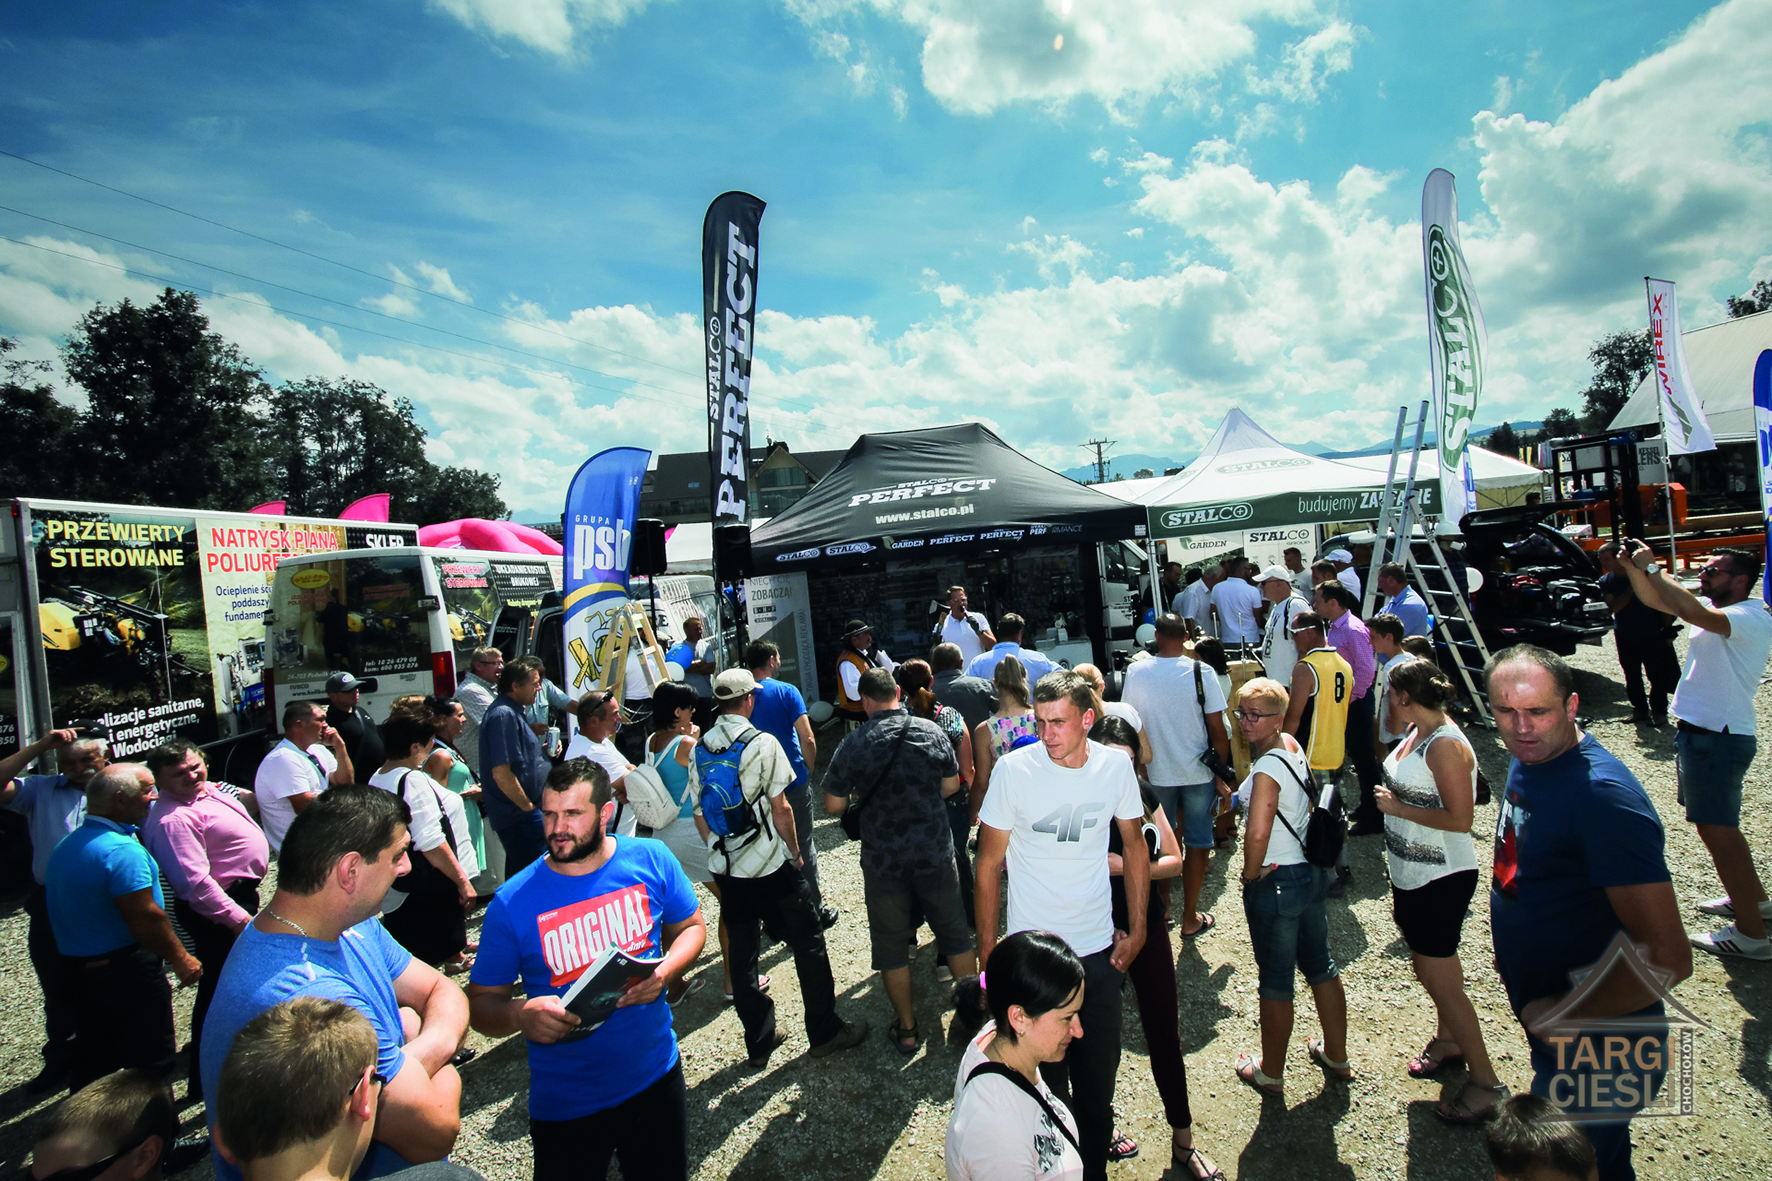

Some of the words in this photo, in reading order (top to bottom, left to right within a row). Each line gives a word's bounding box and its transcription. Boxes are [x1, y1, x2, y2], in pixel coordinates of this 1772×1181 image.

[1430, 239, 1476, 449] STALCO
[1653, 293, 1672, 395] WIREX
[709, 316, 721, 420] STALCO
[716, 221, 756, 521] PERFECT
[1224, 458, 1308, 473] STALCO
[1638, 452, 1661, 465] ERS
[848, 478, 996, 507] PERFECT
[898, 477, 947, 489] STALCO
[875, 503, 974, 524] www.stalco.pl
[1168, 504, 1249, 527] STALCO
[1298, 495, 1357, 515] budujemy
[575, 514, 610, 525] GRUPA
[47, 519, 185, 542] PRZEWIERTY
[211, 527, 292, 549] NATRYSK
[294, 531, 339, 552] PIANĄ
[891, 540, 924, 549] GARDEN
[929, 534, 975, 546] PERFECT
[980, 530, 1025, 540] PERFECT
[1249, 528, 1310, 543] STALCO
[780, 549, 818, 560] STALCO
[829, 543, 869, 554] STALCO
[1189, 540, 1228, 550] GARDEN
[50, 547, 185, 568] STEROWANE
[215, 585, 259, 598] Ocieplenie
[751, 586, 793, 601] ZOBACZĄ!
[232, 597, 270, 611] poddaszy
[1334, 671, 1346, 704] 8
[148, 697, 205, 718] sanitarne,
[116, 712, 200, 741] energetyczne,
[1031, 801, 1106, 843] 4F
[543, 889, 653, 976] ORIGINAL
